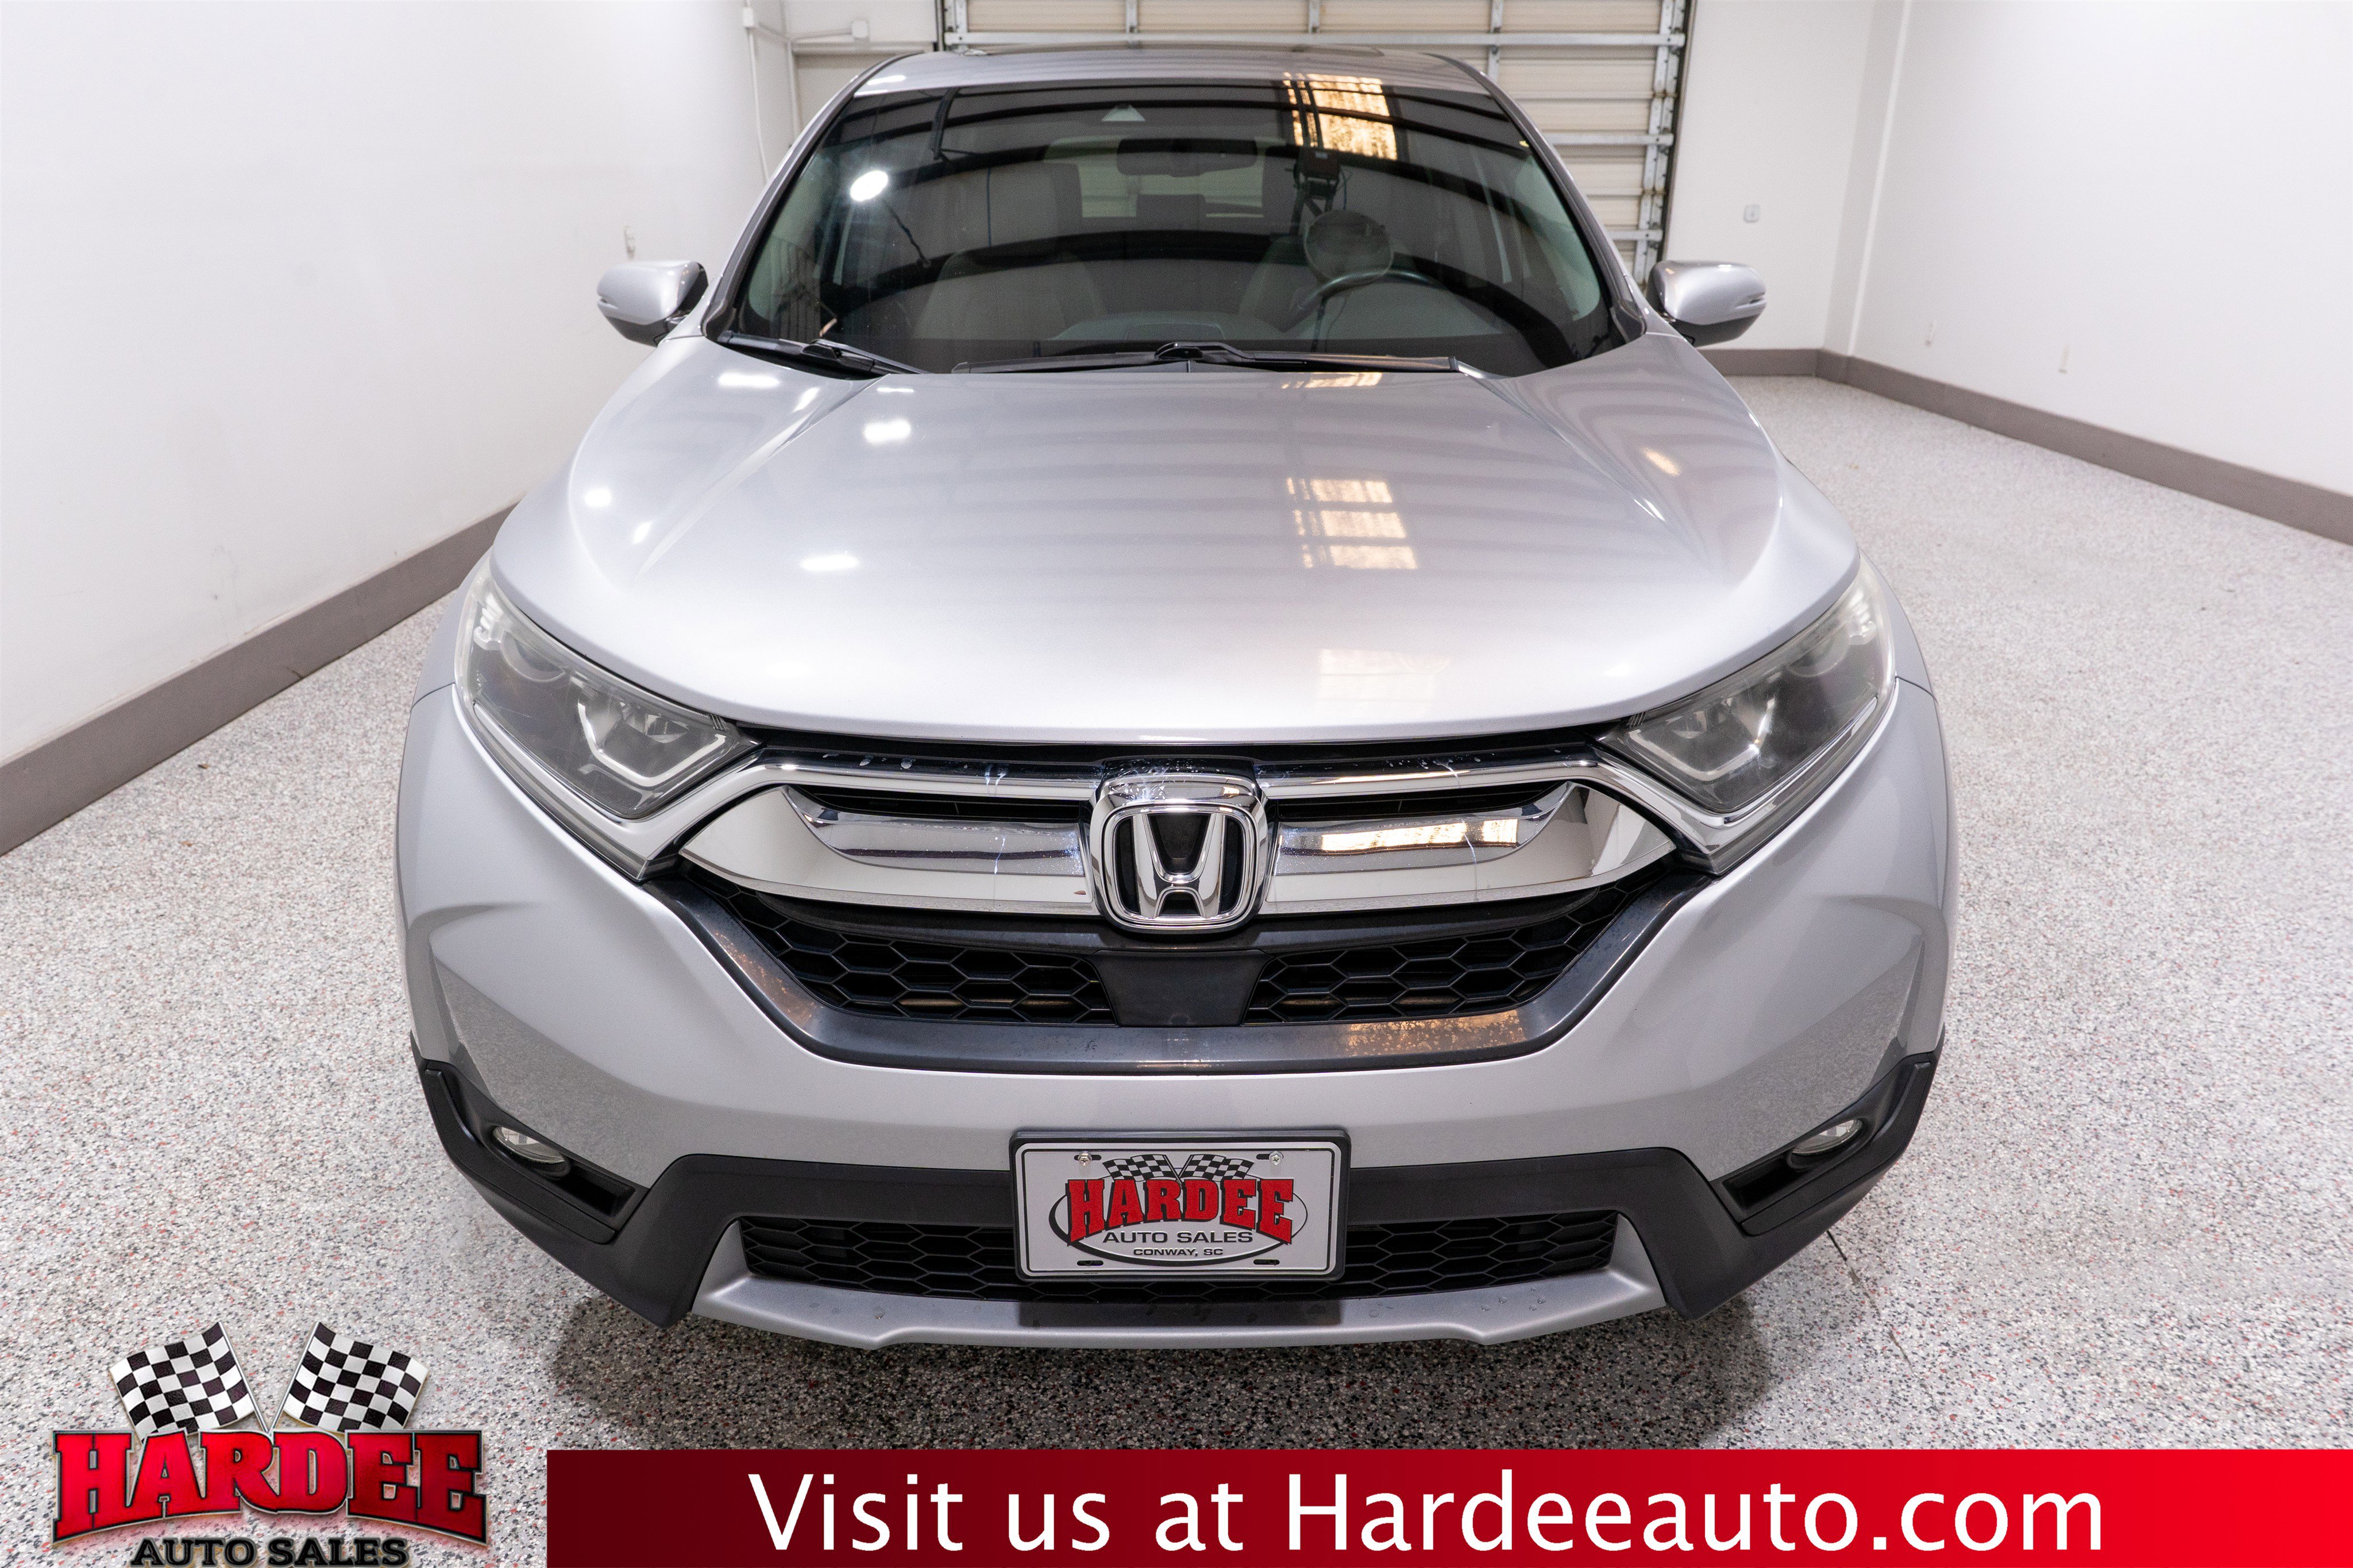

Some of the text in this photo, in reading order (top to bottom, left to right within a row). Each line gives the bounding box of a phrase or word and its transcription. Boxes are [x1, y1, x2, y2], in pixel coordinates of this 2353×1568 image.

[1066, 1179, 1294, 1246] HARDEE
[1102, 1231, 1253, 1243] AUTO SALES
[1133, 1248, 1198, 1257] CONWAY,
